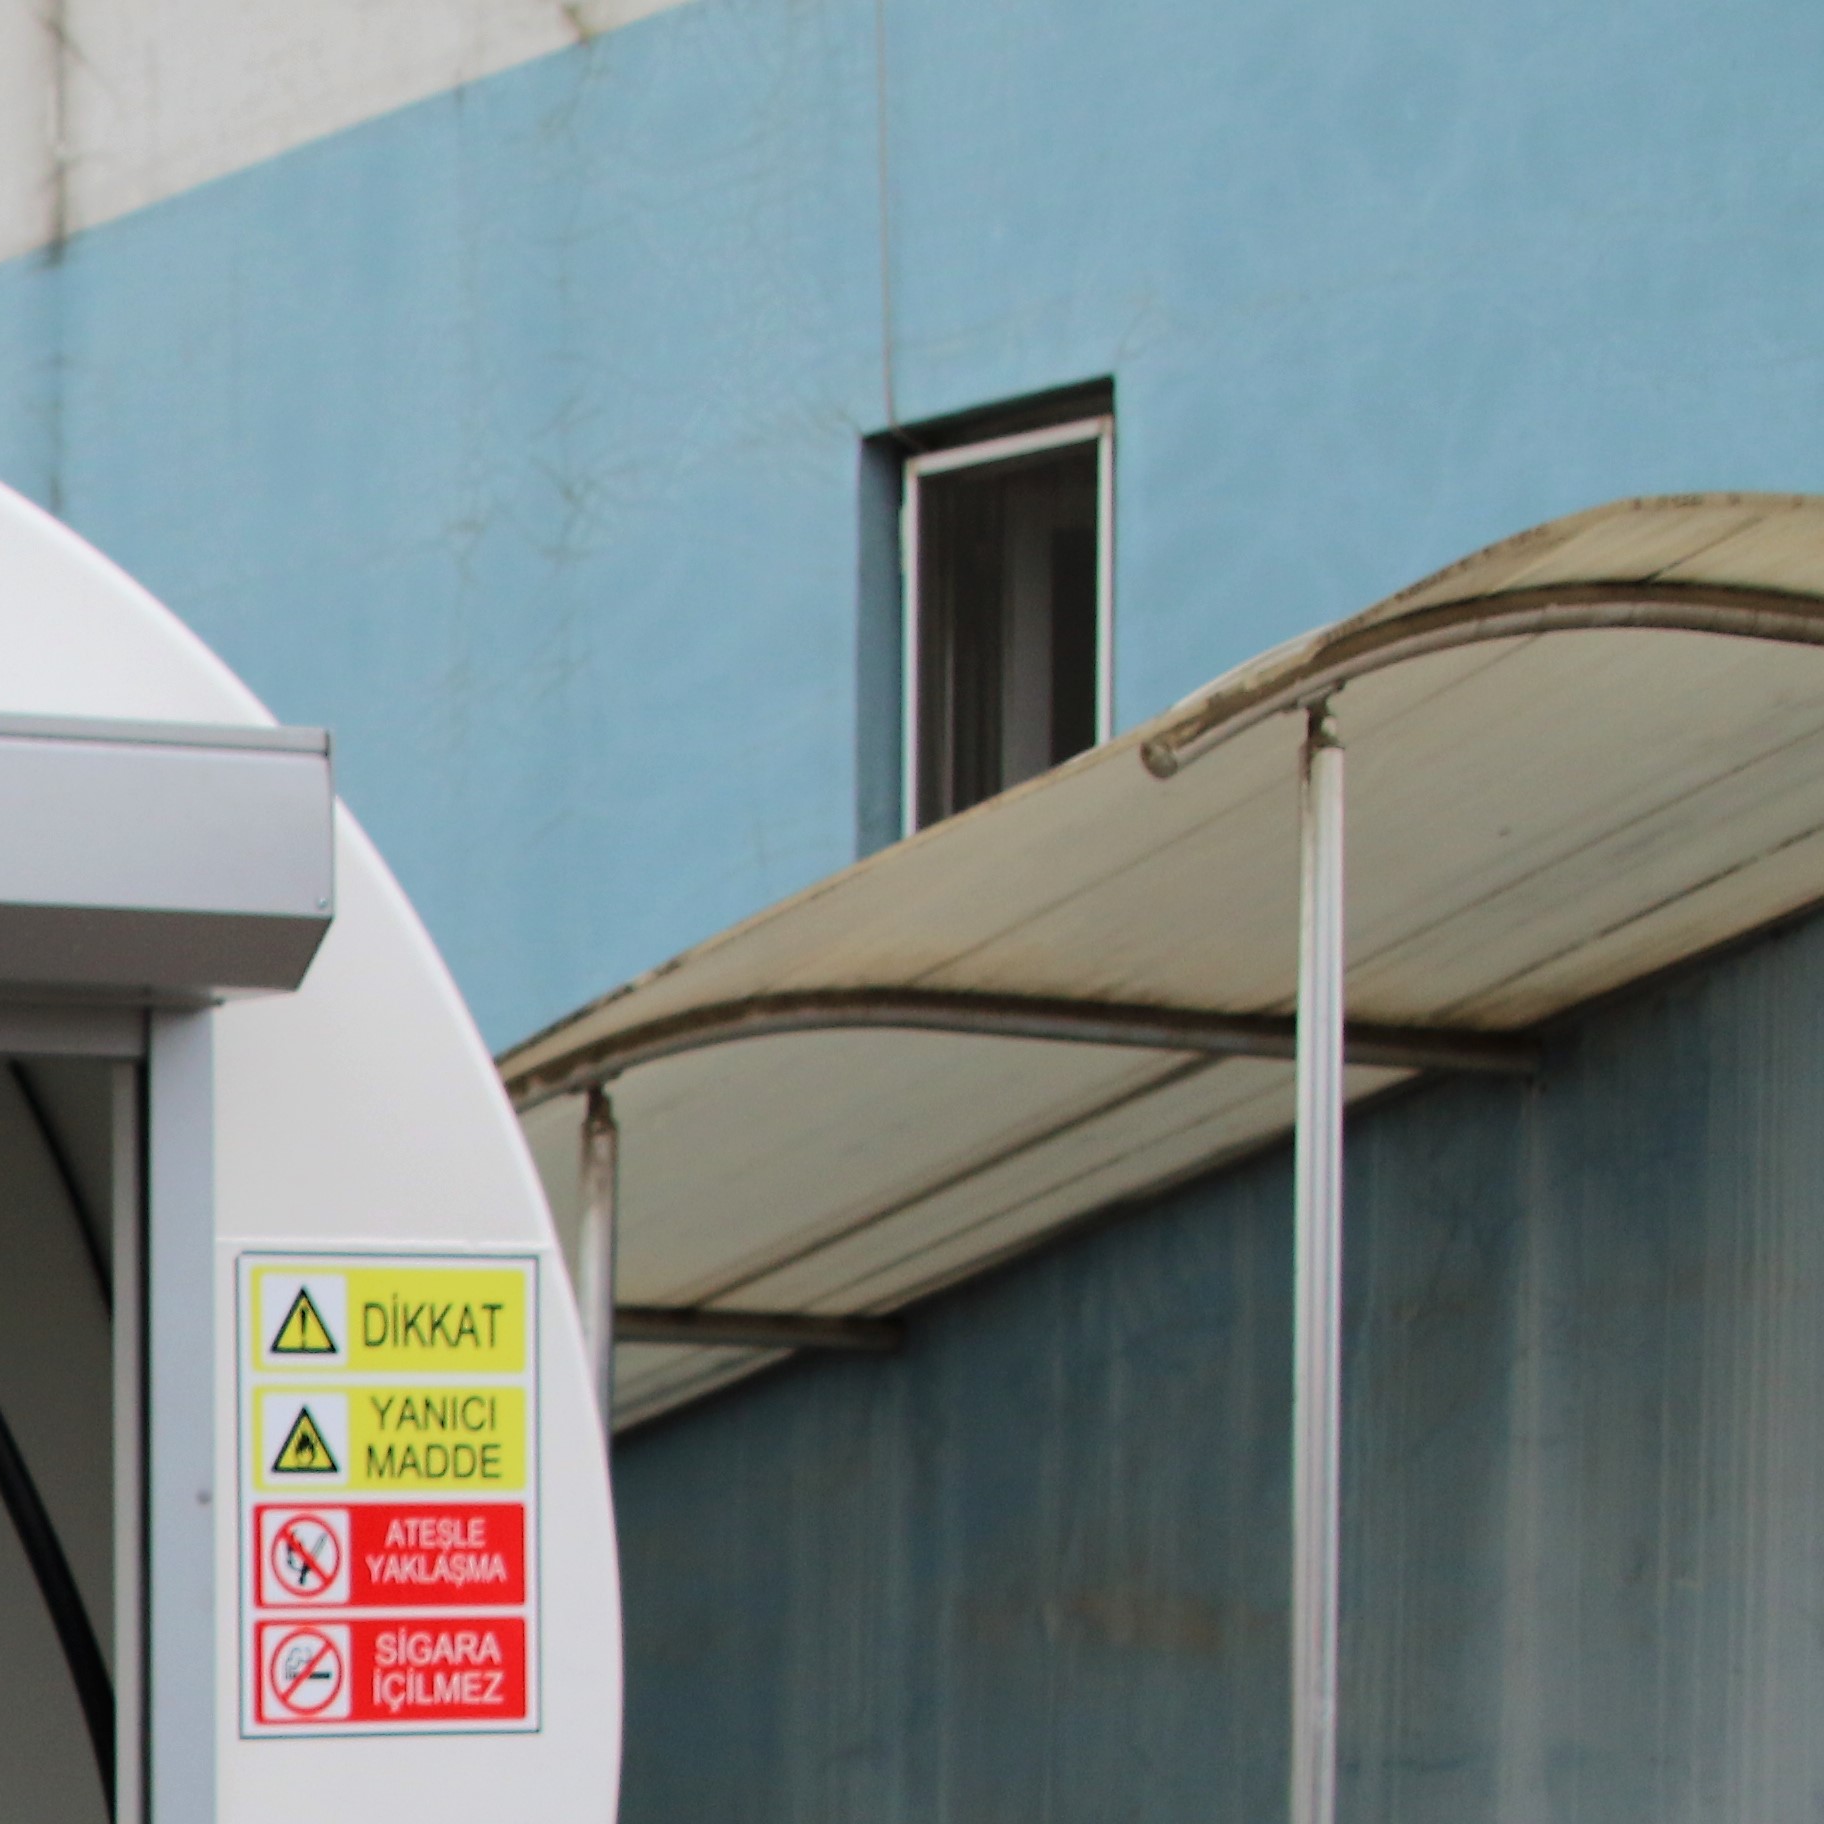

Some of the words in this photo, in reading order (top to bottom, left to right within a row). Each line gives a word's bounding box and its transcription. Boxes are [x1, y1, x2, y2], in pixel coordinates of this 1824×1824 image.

[362, 1292, 505, 1349] DİKKAT
[371, 1395, 496, 1433] YANICI
[365, 1443, 502, 1480] MADDE
[385, 1518, 485, 1553] ATEŞLE
[365, 1555, 506, 1588] YAKLAŞMA
[374, 1626, 502, 1666] SİGARA
[371, 1669, 506, 1713] İÇİLMEZ
